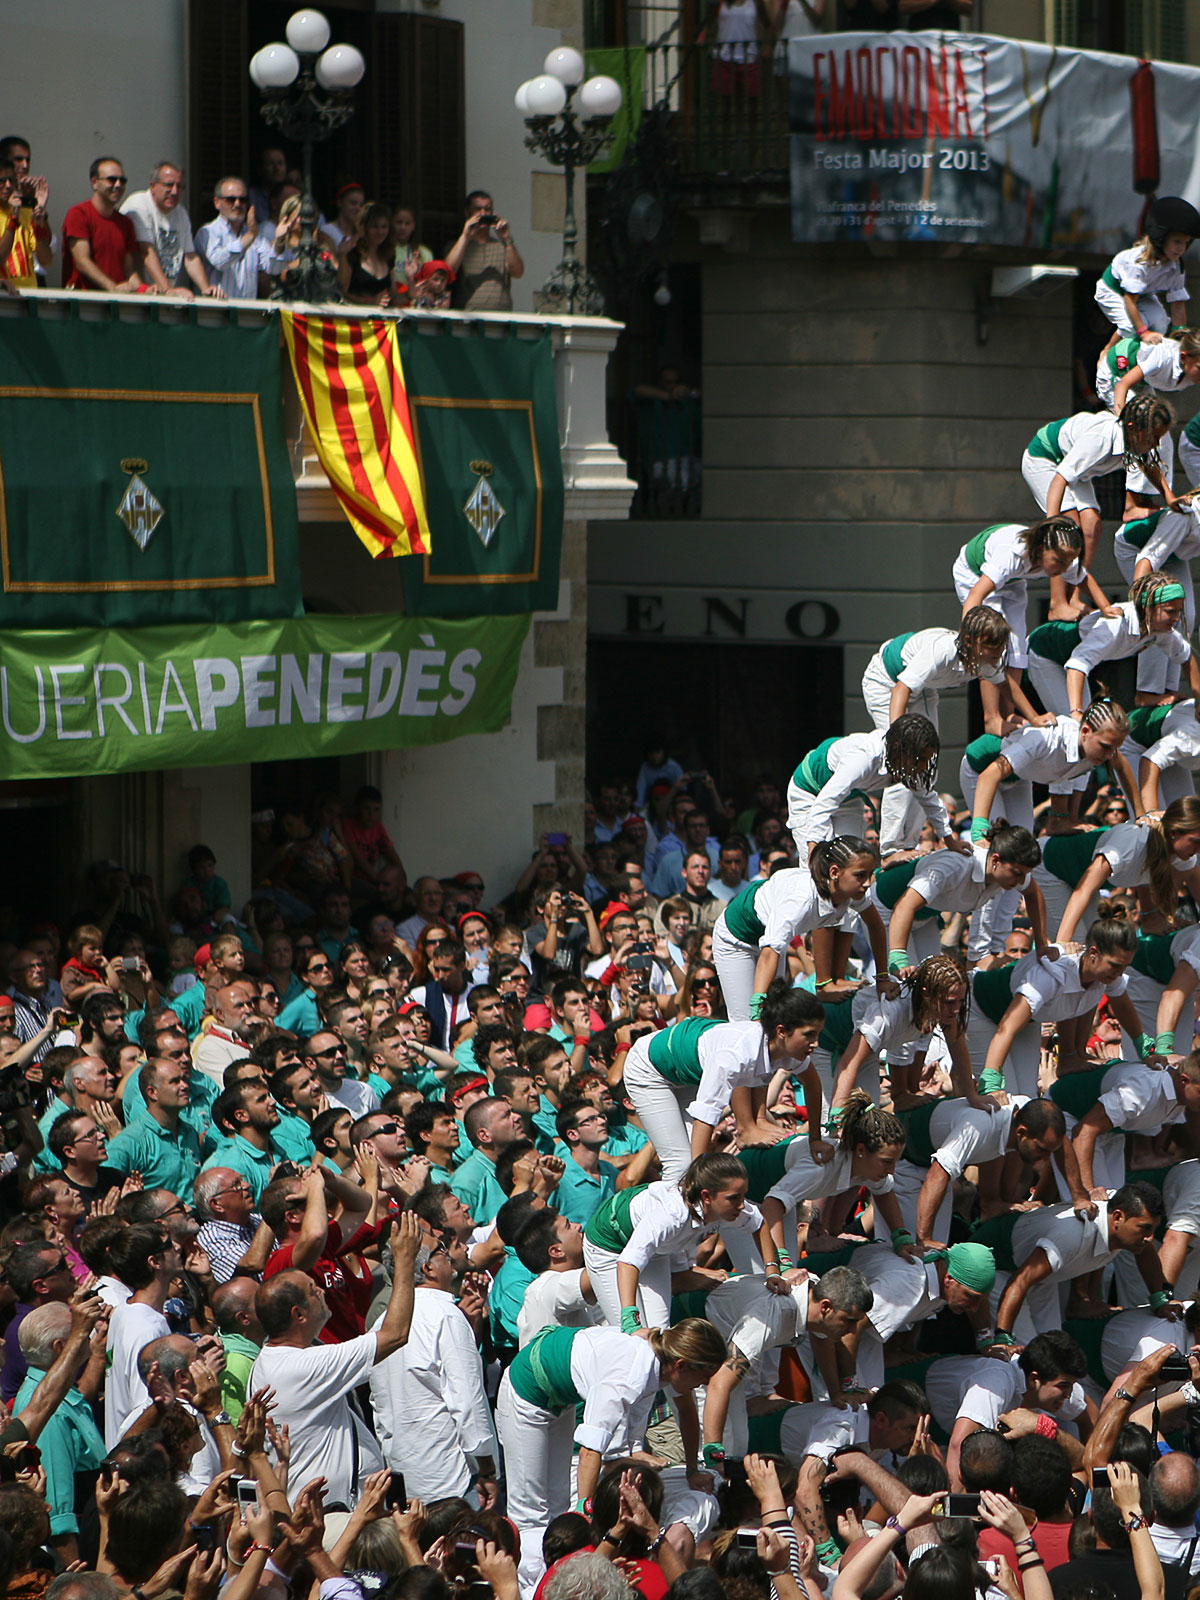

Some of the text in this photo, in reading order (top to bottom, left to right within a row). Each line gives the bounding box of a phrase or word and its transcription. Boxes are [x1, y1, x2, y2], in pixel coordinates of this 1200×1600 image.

[814, 149, 991, 174] Festa Major 2013
[868, 200, 886, 212] del
[887, 200, 937, 213] Penedès
[920, 214, 929, 226] 2
[930, 214, 943, 226] de
